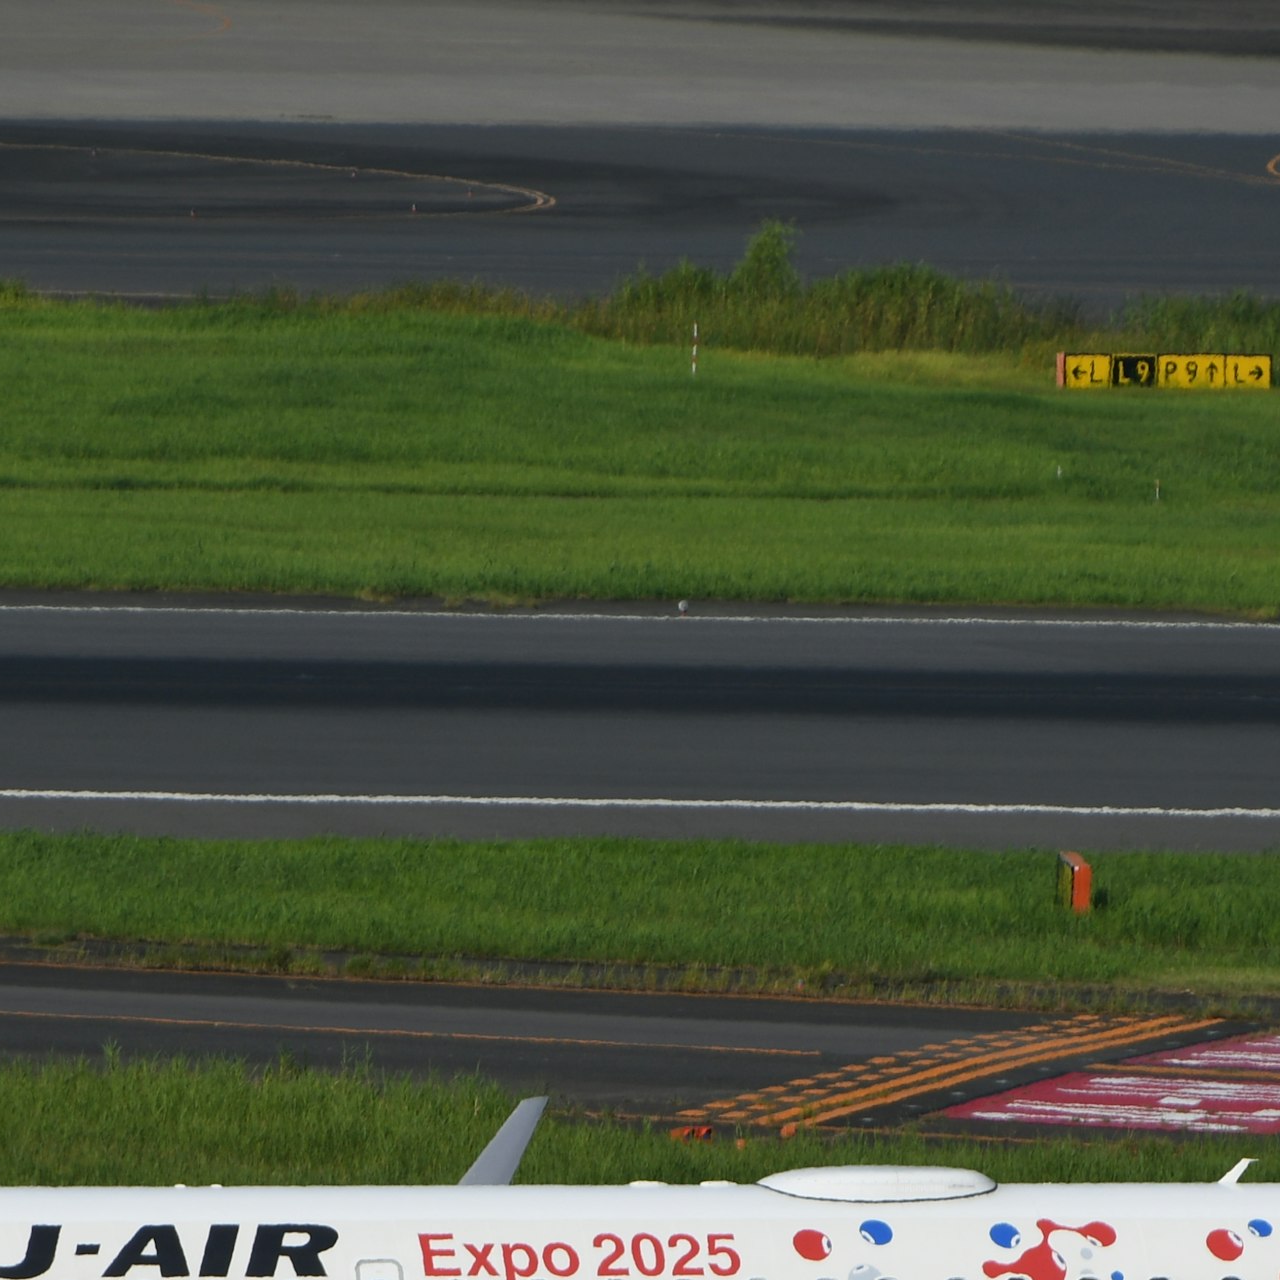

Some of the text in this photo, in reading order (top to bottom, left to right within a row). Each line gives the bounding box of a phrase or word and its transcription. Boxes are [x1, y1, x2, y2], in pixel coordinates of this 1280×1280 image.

[1090, 360, 1103, 383] L
[1118, 360, 1150, 384] L9
[1165, 360, 1198, 383] P9
[592, 1230, 742, 1277] 2025
